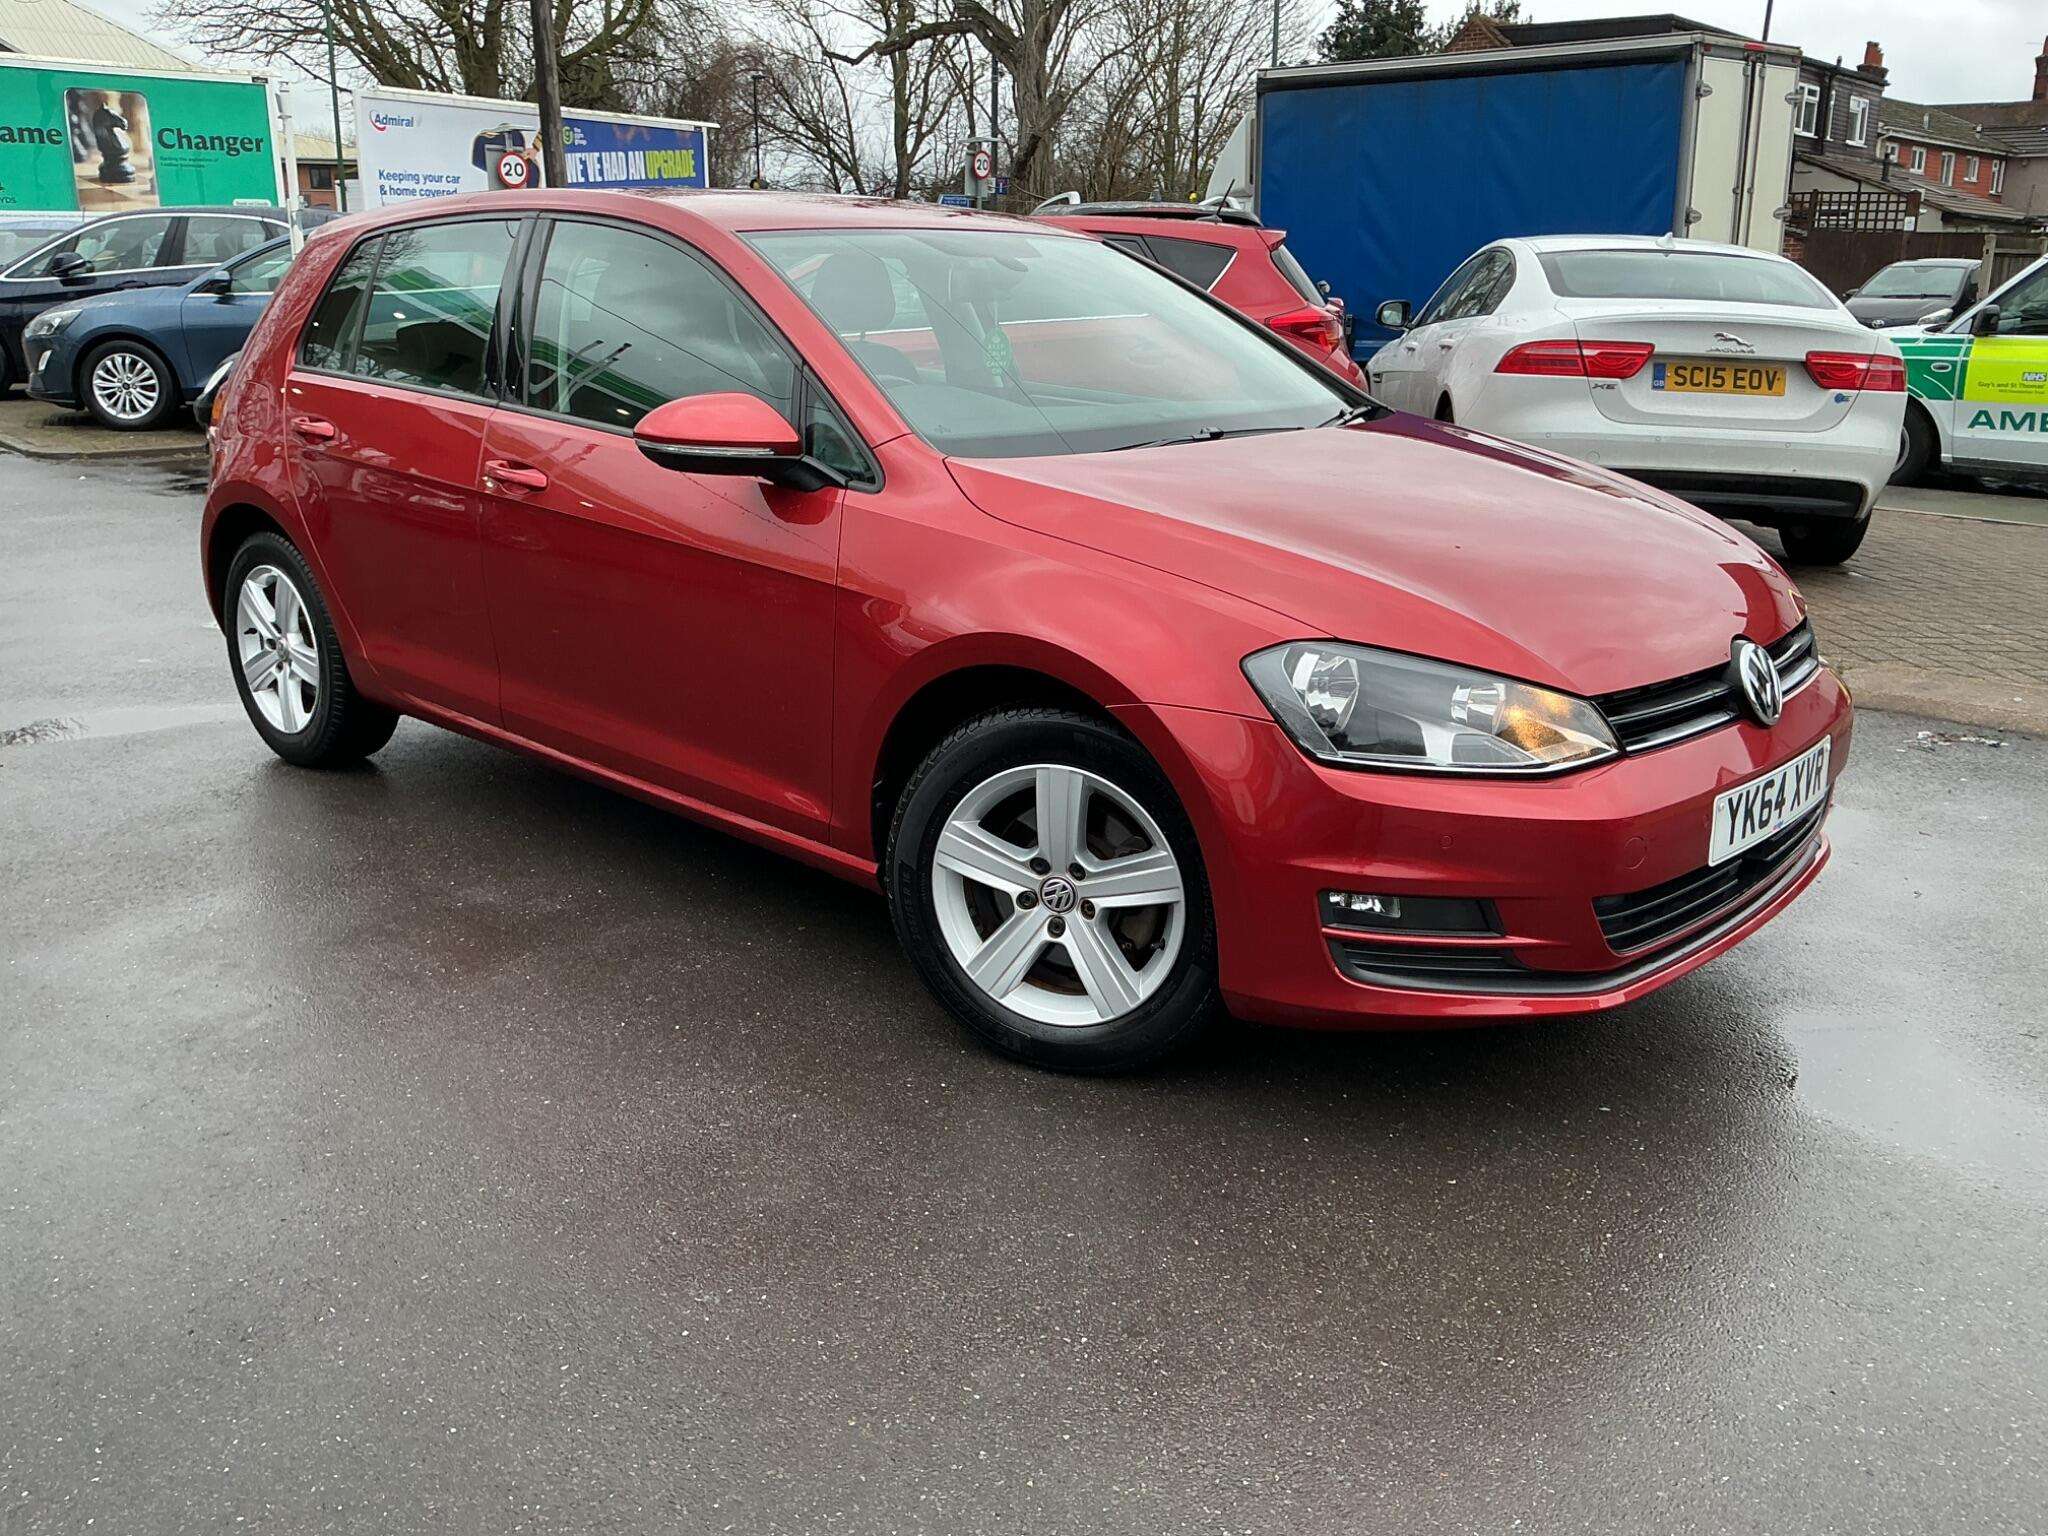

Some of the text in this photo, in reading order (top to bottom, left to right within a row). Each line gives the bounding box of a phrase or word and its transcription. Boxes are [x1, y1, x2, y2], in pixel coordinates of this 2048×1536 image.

[374, 114, 414, 127] Admiral
[157, 127, 264, 156] Changer
[503, 162, 525, 177] 20
[565, 149, 697, 183] WE'VE HAD AN UPGRADE
[977, 159, 988, 171] 20
[378, 169, 461, 185] Keeping your car
[379, 184, 387, 195] &
[389, 185, 417, 196] home
[1673, 365, 1778, 391] SC15 EOV
[2023, 372, 2046, 381] NHS
[1727, 747, 1825, 845] YK64 XVR
